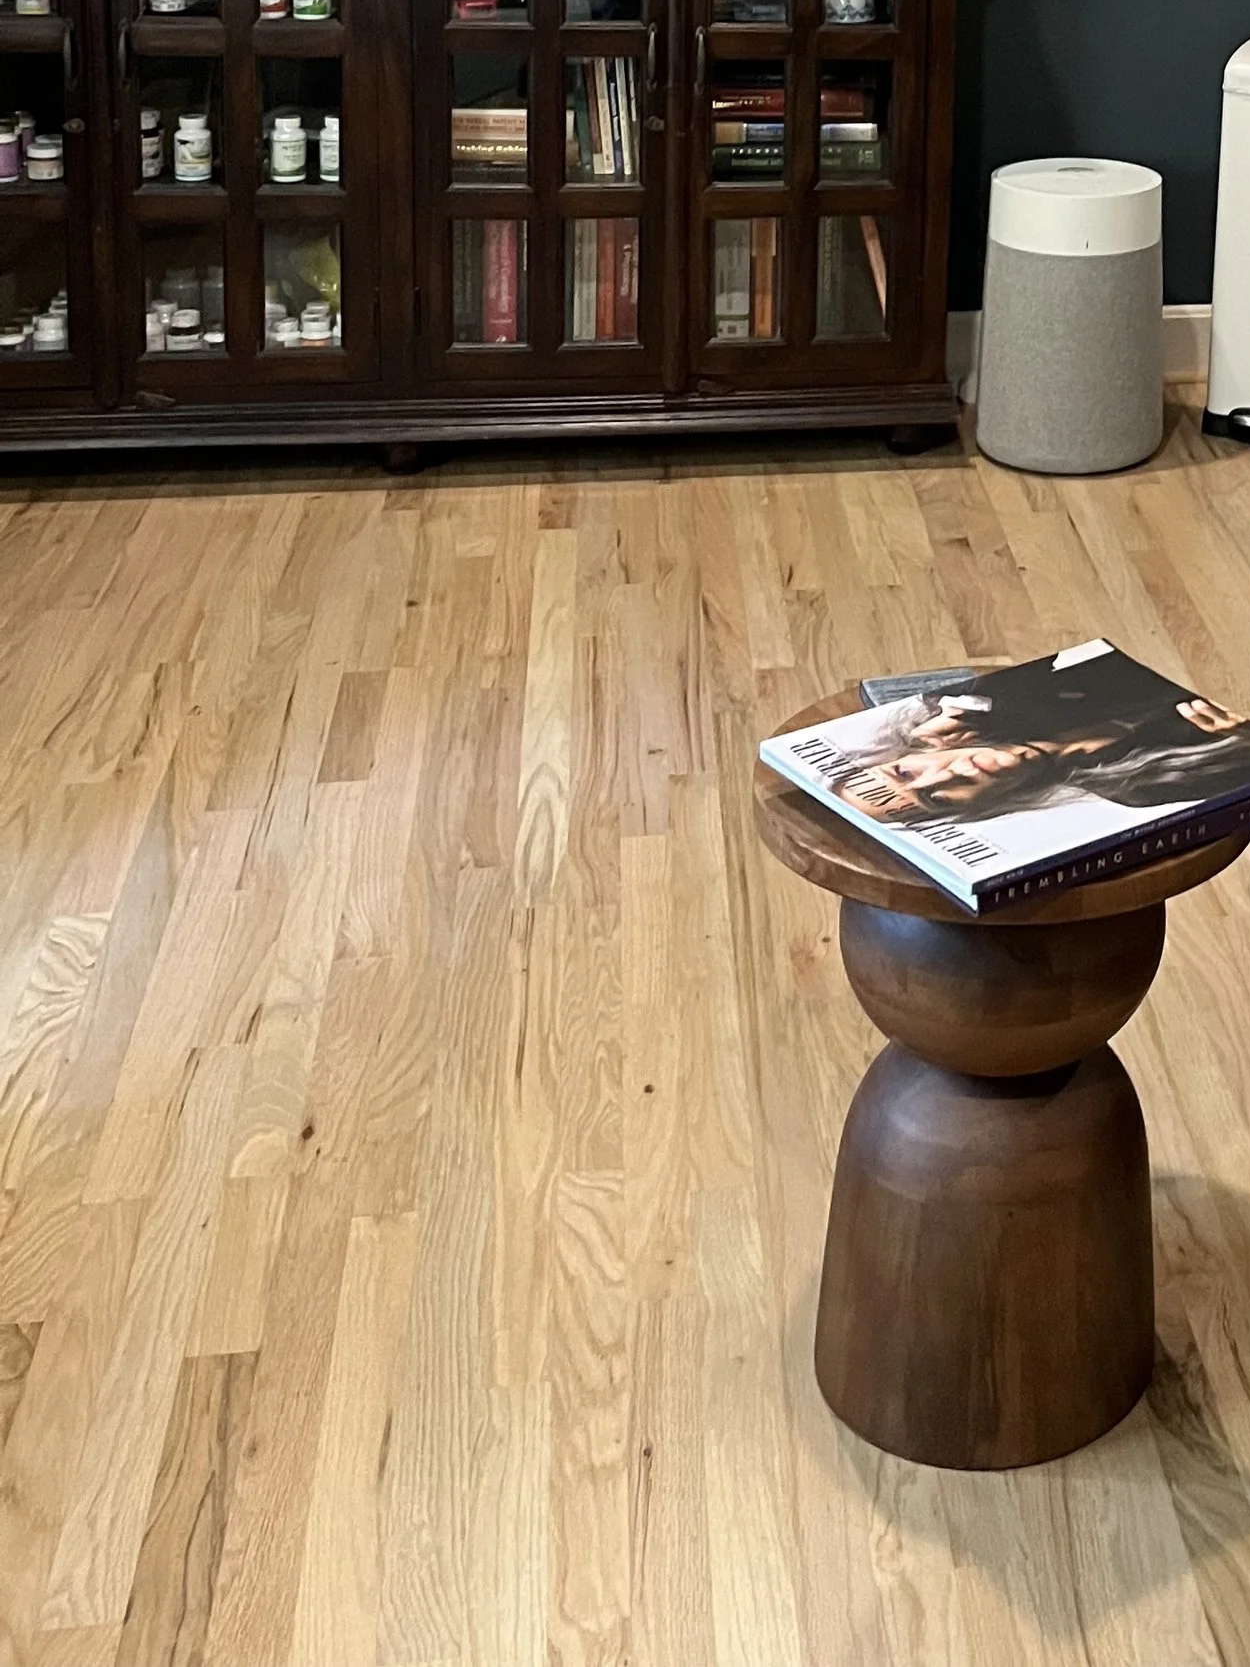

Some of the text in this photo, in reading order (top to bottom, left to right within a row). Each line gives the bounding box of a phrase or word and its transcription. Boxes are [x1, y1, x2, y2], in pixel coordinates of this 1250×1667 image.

[942, 837, 1000, 867] THE
[993, 852, 1124, 903] TREMBLING
[1141, 825, 1207, 854] EARTH
